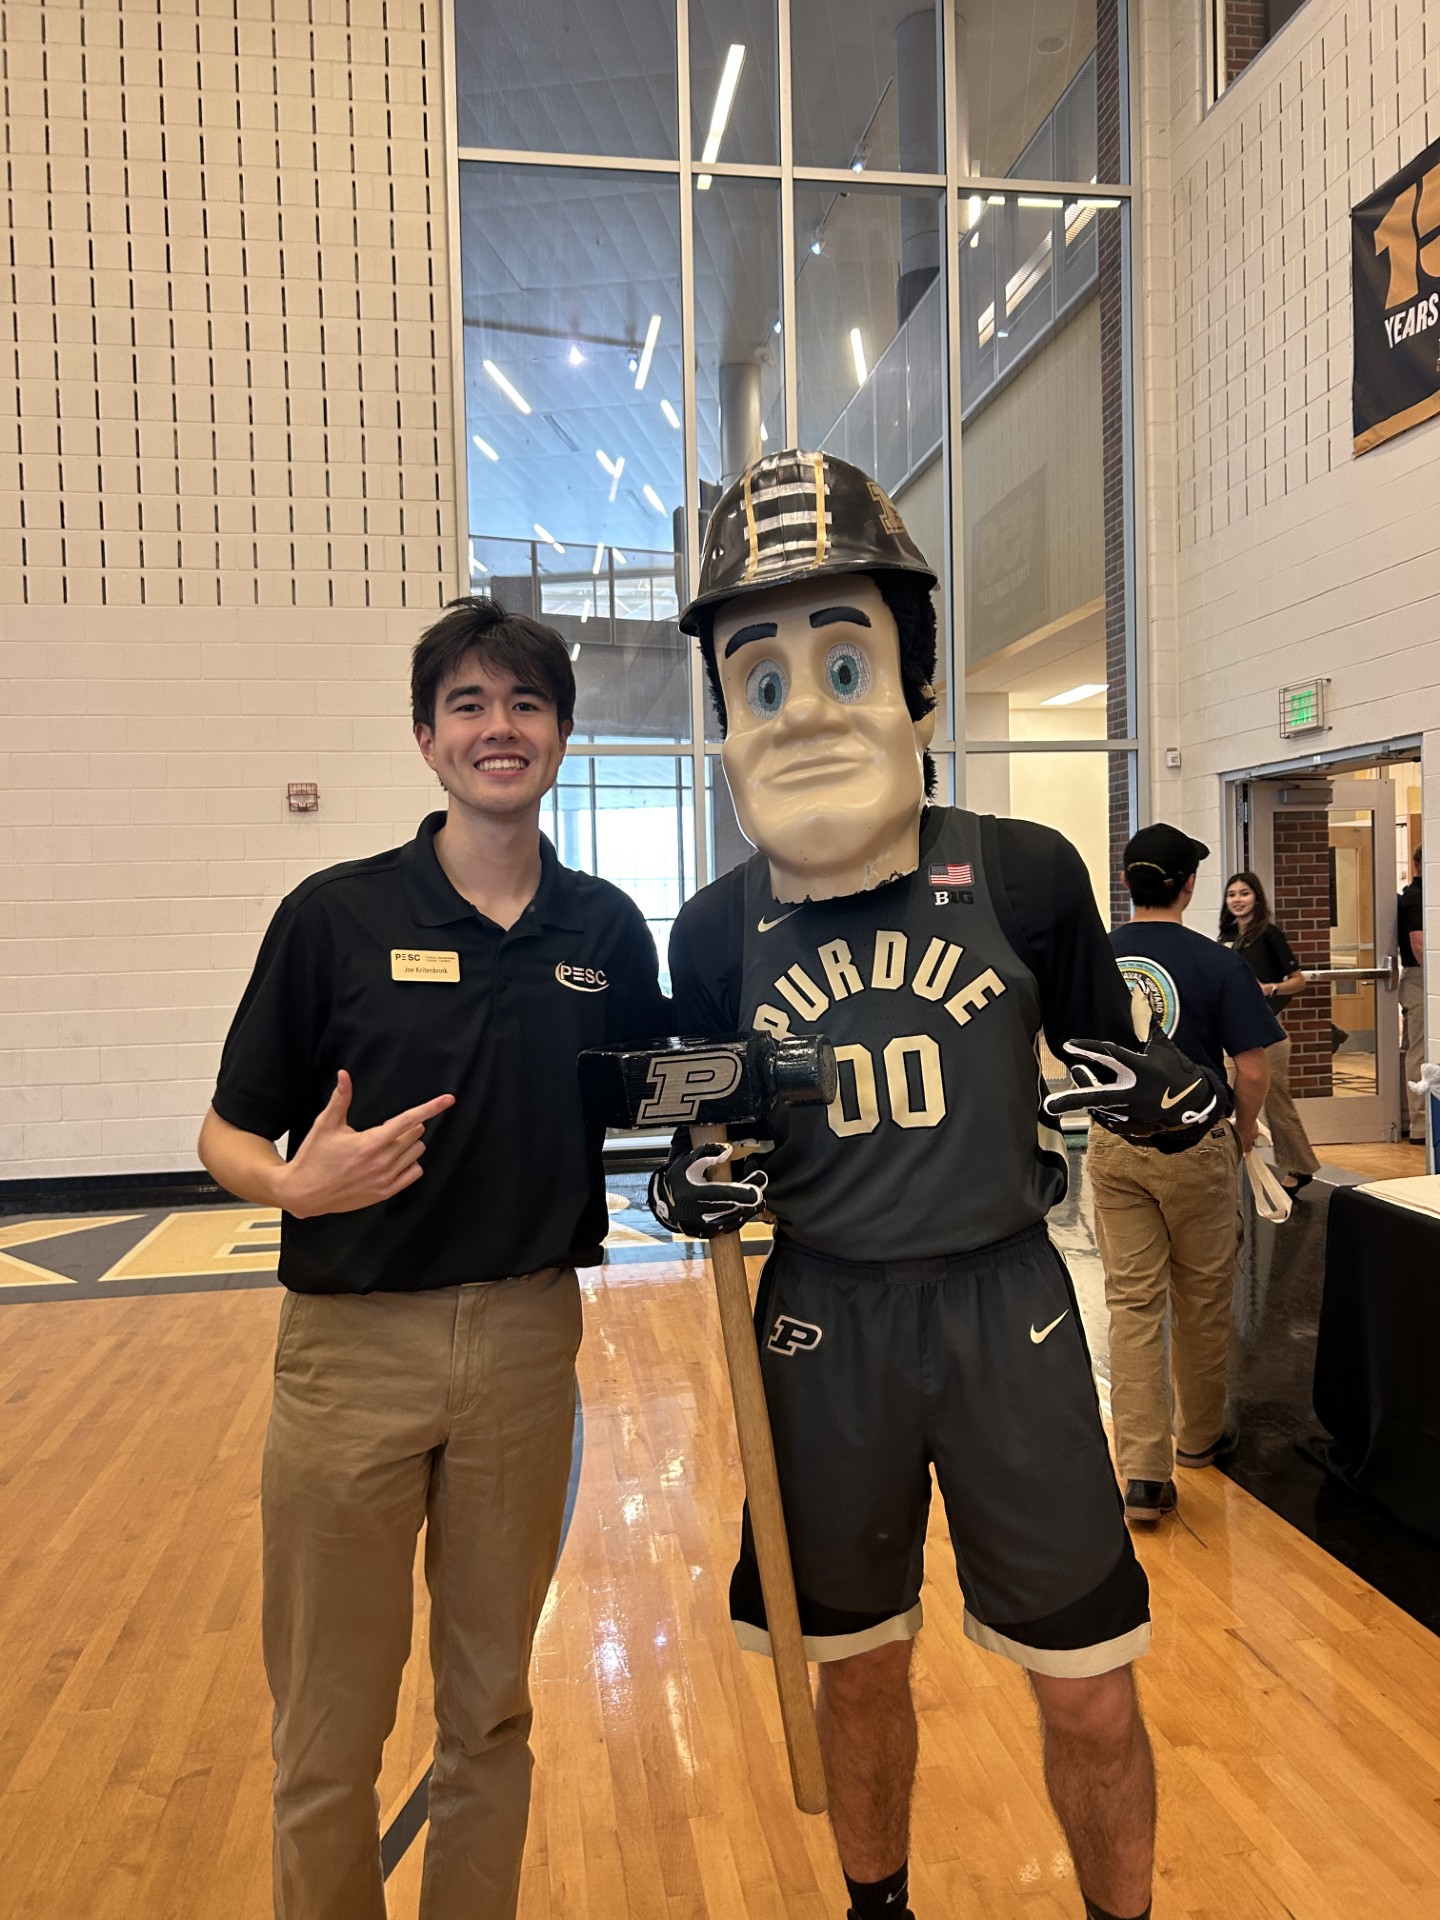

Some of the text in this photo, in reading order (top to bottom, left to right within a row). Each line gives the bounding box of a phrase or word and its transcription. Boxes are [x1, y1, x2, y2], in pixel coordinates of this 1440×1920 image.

[1385, 291, 1439, 349] YEARS
[395, 953, 421, 962] PESC
[560, 965, 608, 985] PESC
[752, 930, 1007, 1042] PURDUE
[636, 1051, 743, 1125] P
[827, 1034, 947, 1138] 00
[767, 1314, 823, 1356] P
